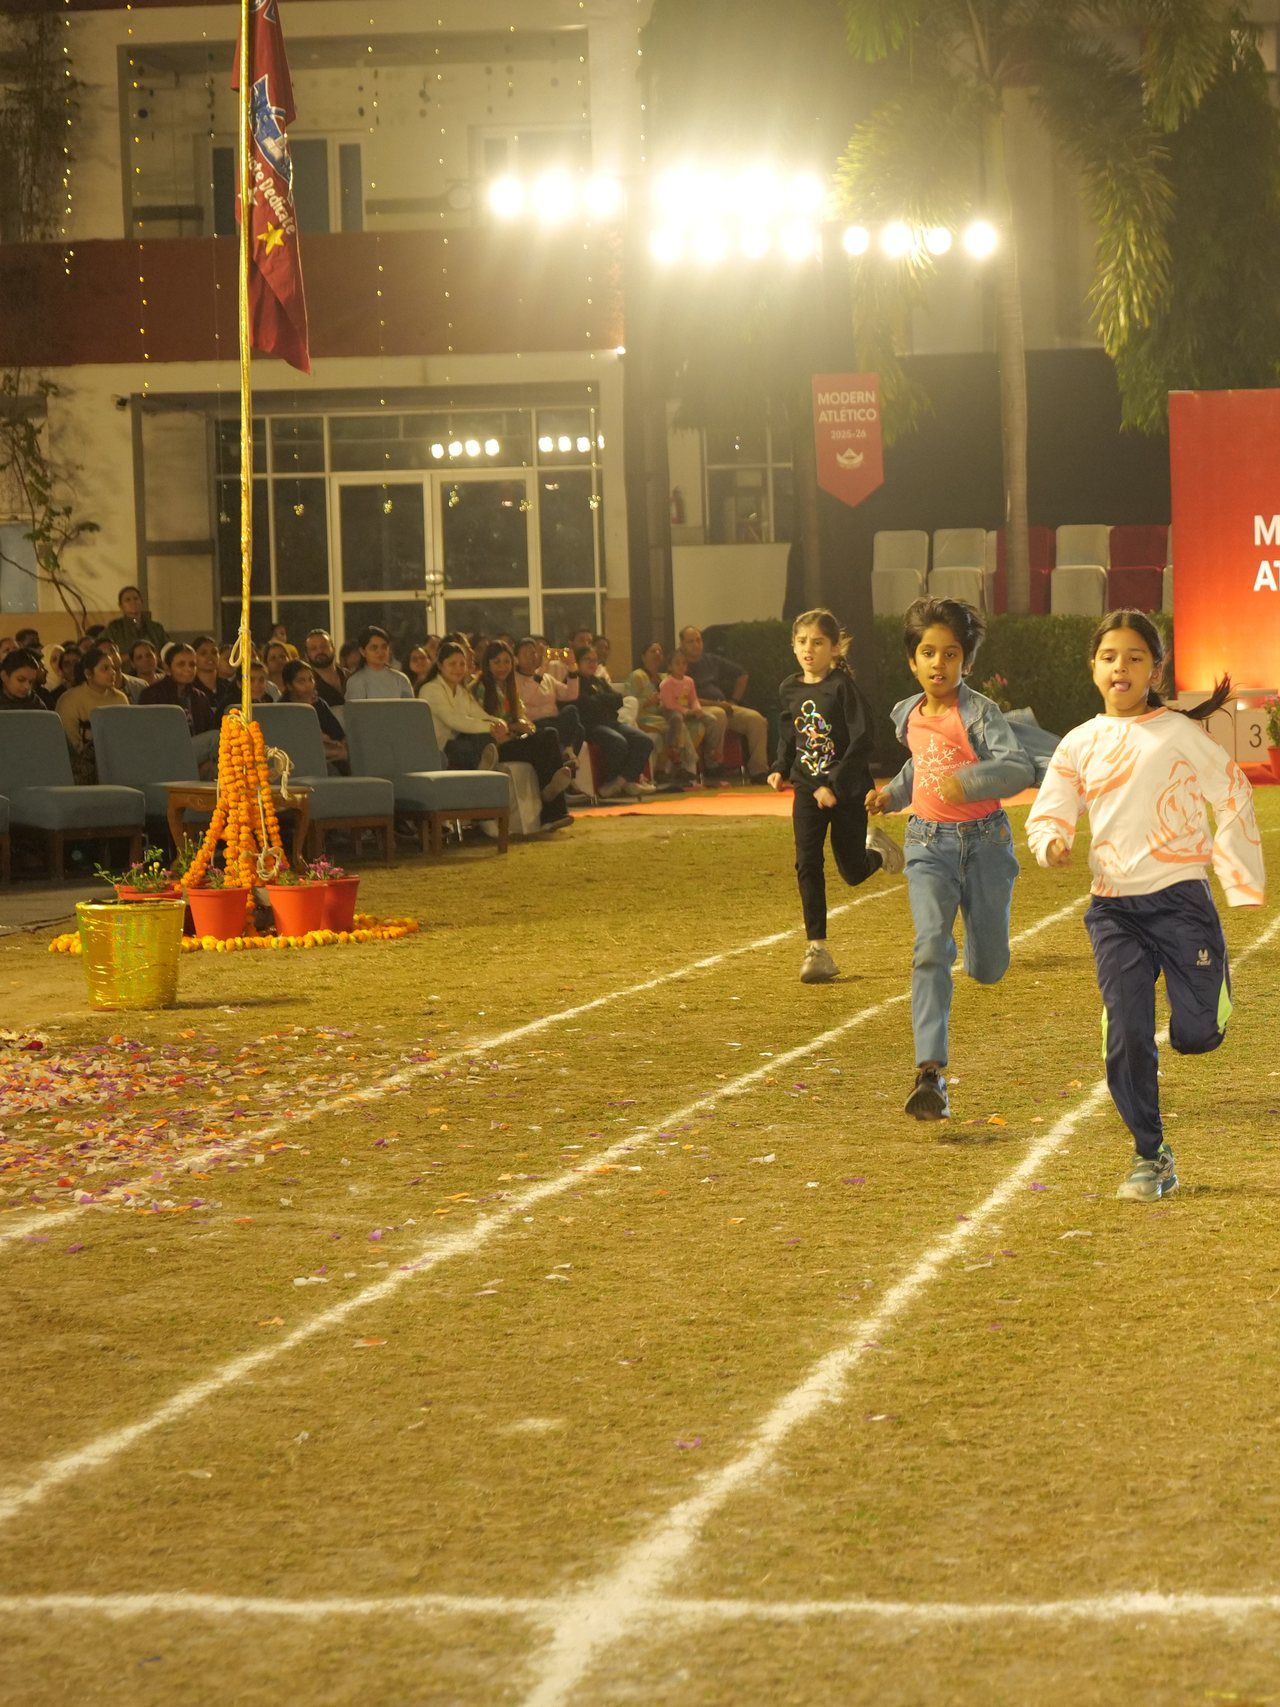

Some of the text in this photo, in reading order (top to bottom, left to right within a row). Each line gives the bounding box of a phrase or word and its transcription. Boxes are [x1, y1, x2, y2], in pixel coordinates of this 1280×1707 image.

[259, 177, 296, 235] Dedicate
[817, 390, 876, 405] MODERN
[818, 406, 877, 423] ATLÉTICO
[1249, 723, 1262, 748] 3
